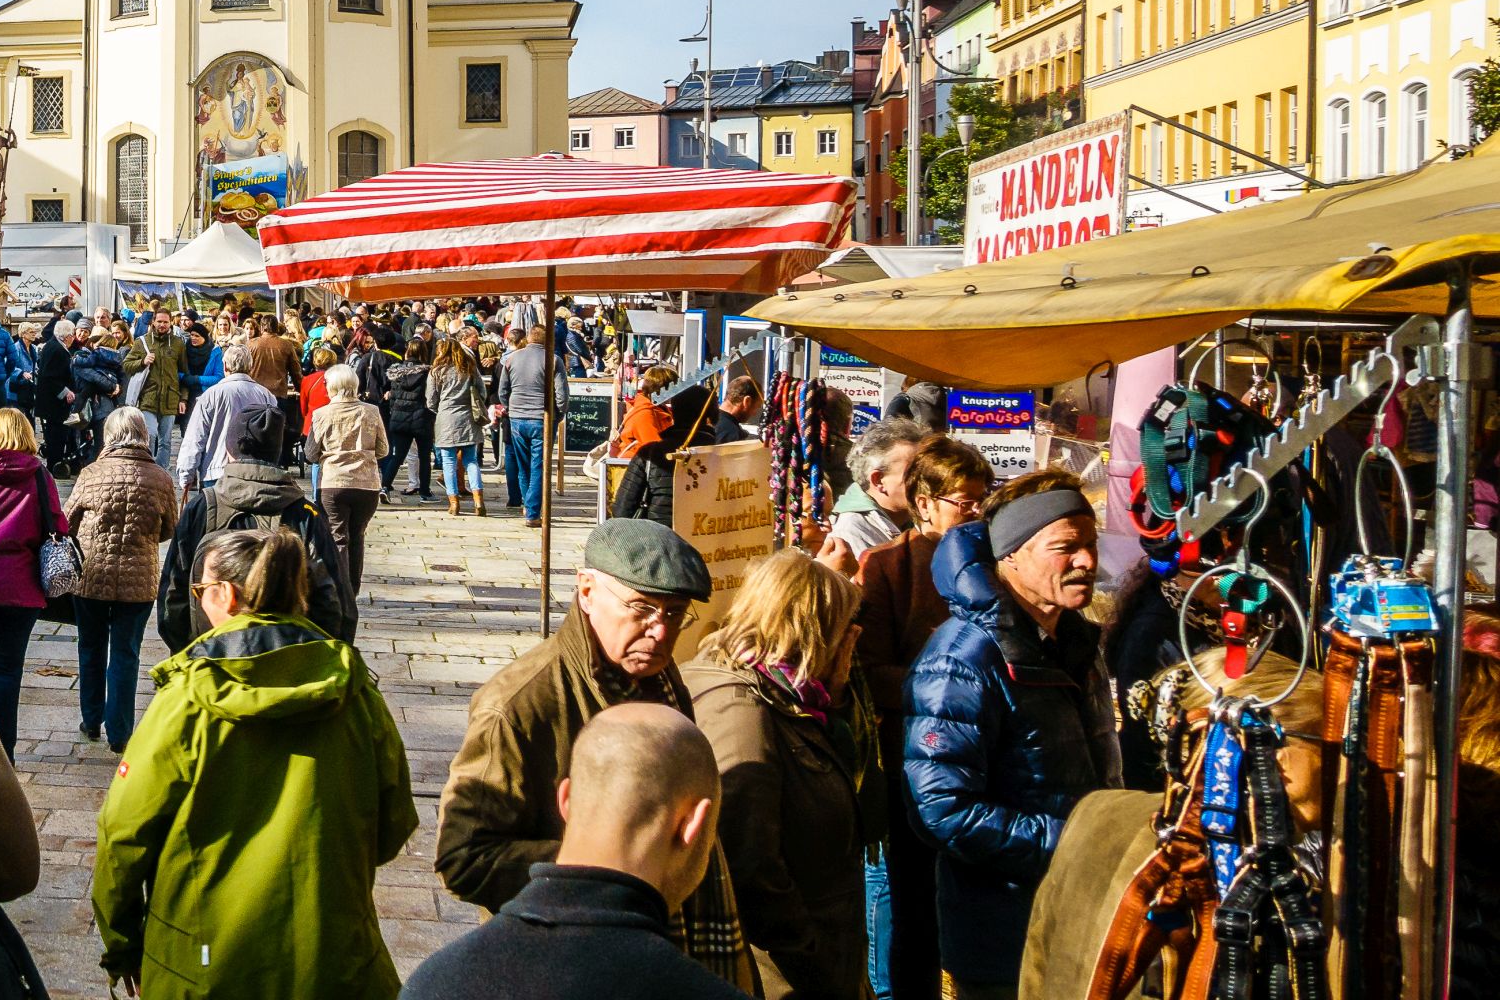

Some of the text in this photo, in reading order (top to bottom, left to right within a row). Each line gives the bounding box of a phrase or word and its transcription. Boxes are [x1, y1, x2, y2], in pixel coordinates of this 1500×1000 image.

[999, 135, 1119, 221] MANDELN
[847, 374, 882, 388] gebrannte
[962, 396, 1019, 408] knusprige
[950, 408, 1031, 425] Paranüsse
[981, 443, 1031, 454] gebrannte
[988, 453, 1028, 468] üsse
[715, 477, 759, 501] Natur-
[691, 503, 772, 536] Kauartikel
[714, 544, 768, 561] Oberbayern
